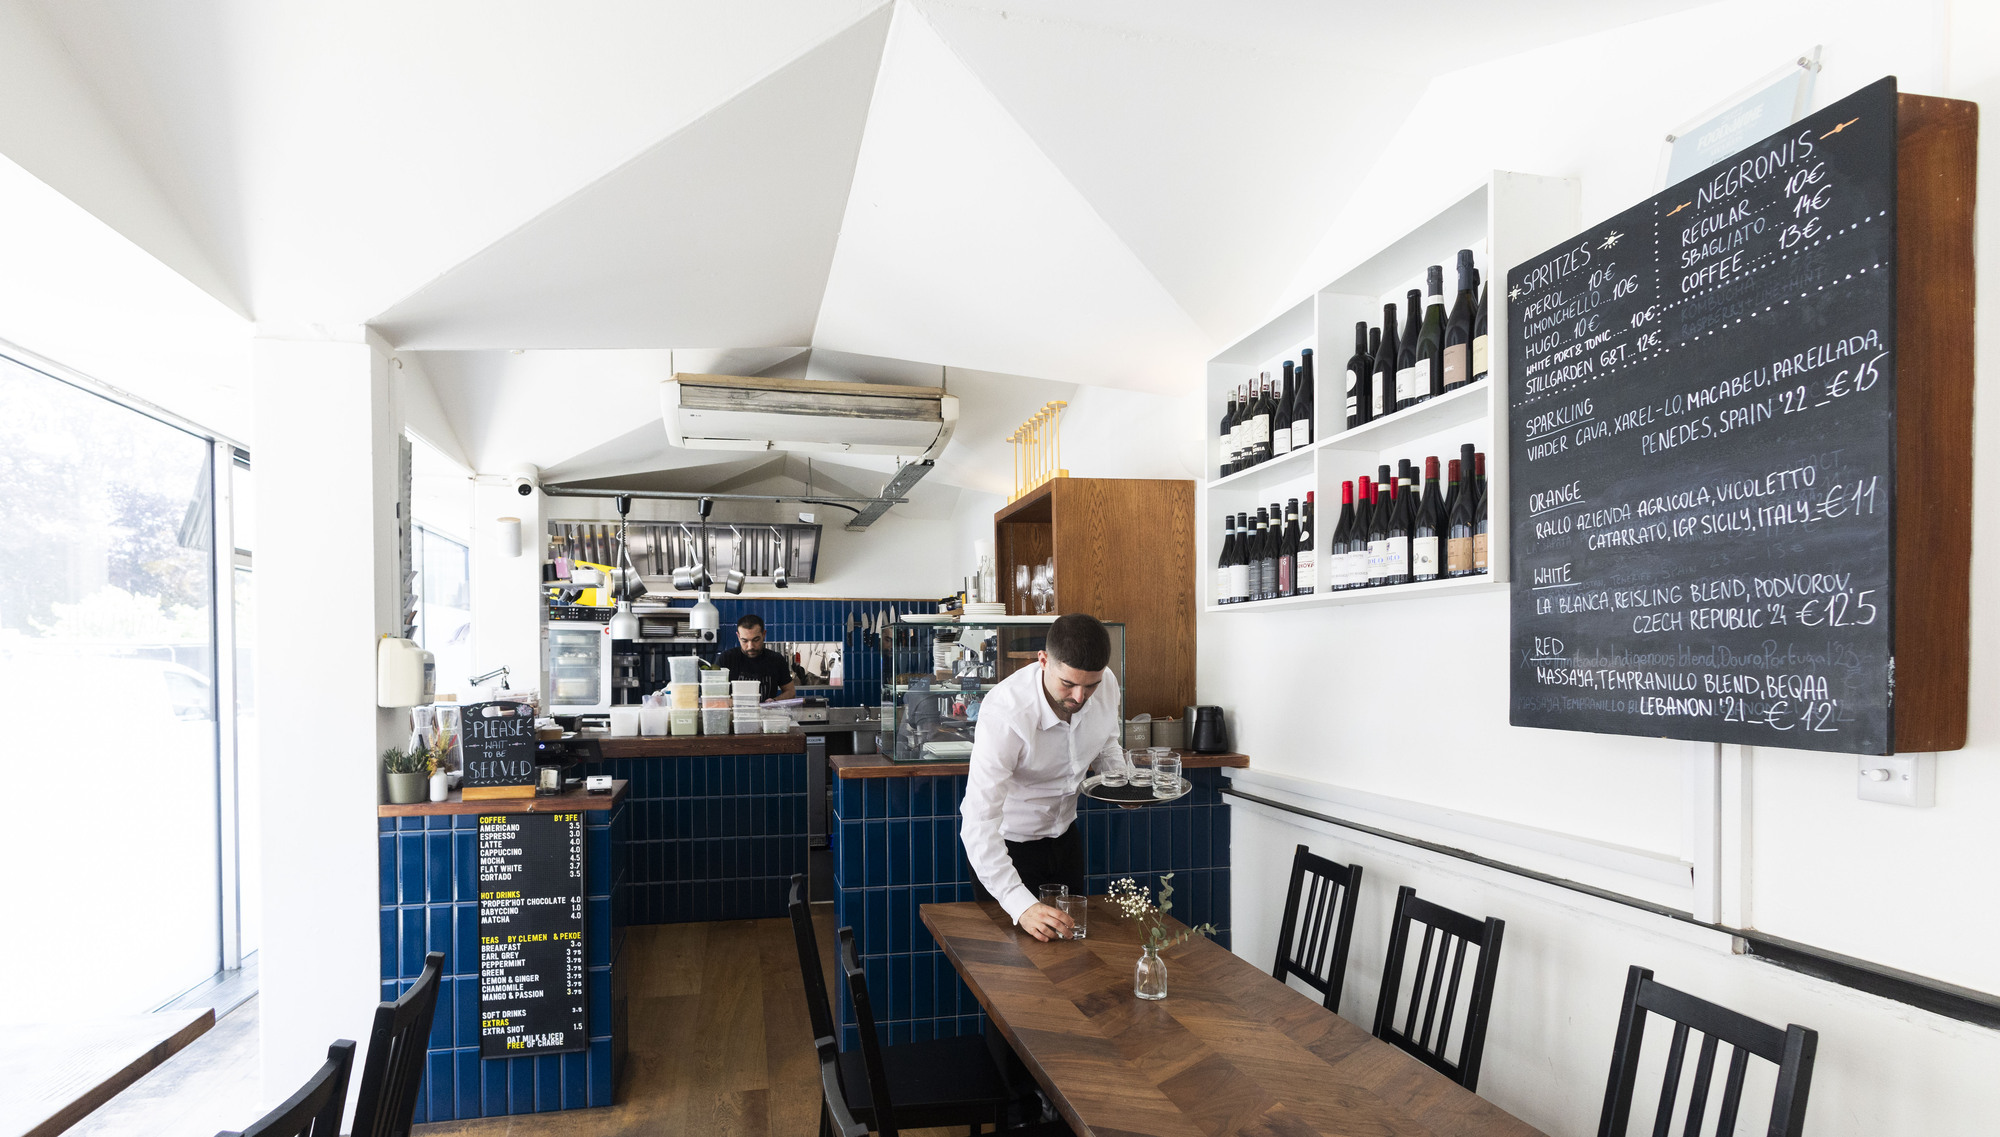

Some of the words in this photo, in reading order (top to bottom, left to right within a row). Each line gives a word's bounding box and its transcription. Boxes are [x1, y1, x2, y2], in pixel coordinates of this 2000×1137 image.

[1697, 130, 1812, 209] NEGRONIS
[1682, 199, 1751, 247] REGULAR
[1784, 162, 1824, 197] 10€
[1681, 217, 1765, 269] SBAGLIATO
[1793, 184, 1831, 218] 14€
[1682, 250, 1744, 293] COFFEE
[1779, 217, 1822, 249] 13€
[1523, 242, 1591, 295] SPRITZES
[1523, 291, 1568, 322] APEROL
[1588, 262, 1616, 290] 10€
[1524, 291, 1600, 339] LIMONCHELLO
[1613, 275, 1638, 300] 10€
[1526, 332, 1559, 358] HUGO
[1574, 315, 1600, 338] 10€
[1527, 356, 1551, 376] WHITE
[1584, 329, 1611, 350] TONIC
[1630, 306, 1655, 328] 10€
[1525, 358, 1593, 394] STILLGARDEN
[1600, 344, 1627, 367] G&T
[1637, 331, 1658, 352] 12€
[1526, 398, 1593, 437] SPARKLING
[1720, 399, 1772, 433] SPAIN
[1527, 435, 1568, 462] VIADER
[1530, 481, 1581, 512] ORANGE
[1536, 516, 1571, 540] RALLO
[1577, 504, 1631, 530] AZIENDA
[1717, 466, 1816, 502] VICOLETTO
[1673, 517, 1697, 537] IGP
[1759, 501, 1809, 527] ITALY
[1534, 563, 1571, 585] WHITE
[1537, 599, 1551, 615] LA
[1615, 586, 1682, 609] REISLING
[1633, 612, 1682, 633] CZECH
[1690, 608, 1763, 630] REPUBLIC
[1535, 637, 1564, 656] RED
[1596, 670, 1697, 690] TEMPRANILLO
[1767, 674, 1828, 702] BEQAA
[1640, 696, 1712, 717] LEBANON
[473, 719, 524, 738] PLEASE
[485, 740, 508, 749] WAIT
[469, 761, 531, 778] SERVED
[480, 832, 515, 840] ESPRESSO
[480, 848, 522, 856] CAPPUCCINO
[481, 857, 505, 865] MOCHA
[481, 873, 512, 881] CORTADO
[527, 897, 566, 905] CHOCOLATE
[481, 916, 510, 924] MATCHA
[519, 934, 547, 942] CLEMEN
[560, 932, 581, 940] PEKOE
[482, 943, 521, 952] BREAKFAST
[482, 959, 525, 968] PEPPERMINT
[482, 969, 504, 977] GREEN
[482, 977, 506, 985] LEMON
[515, 974, 539, 982] GINGER
[482, 984, 524, 993] CHAMOMILE
[482, 993, 506, 1001] MANGO
[515, 990, 543, 999] PASSION
[483, 1011, 500, 1019] SOFT
[502, 1010, 526, 1018] DRINKS
[483, 1019, 509, 1027] EXTRAS
[483, 1027, 505, 1035] EXTRA
[538, 1039, 564, 1047] CHARGE
